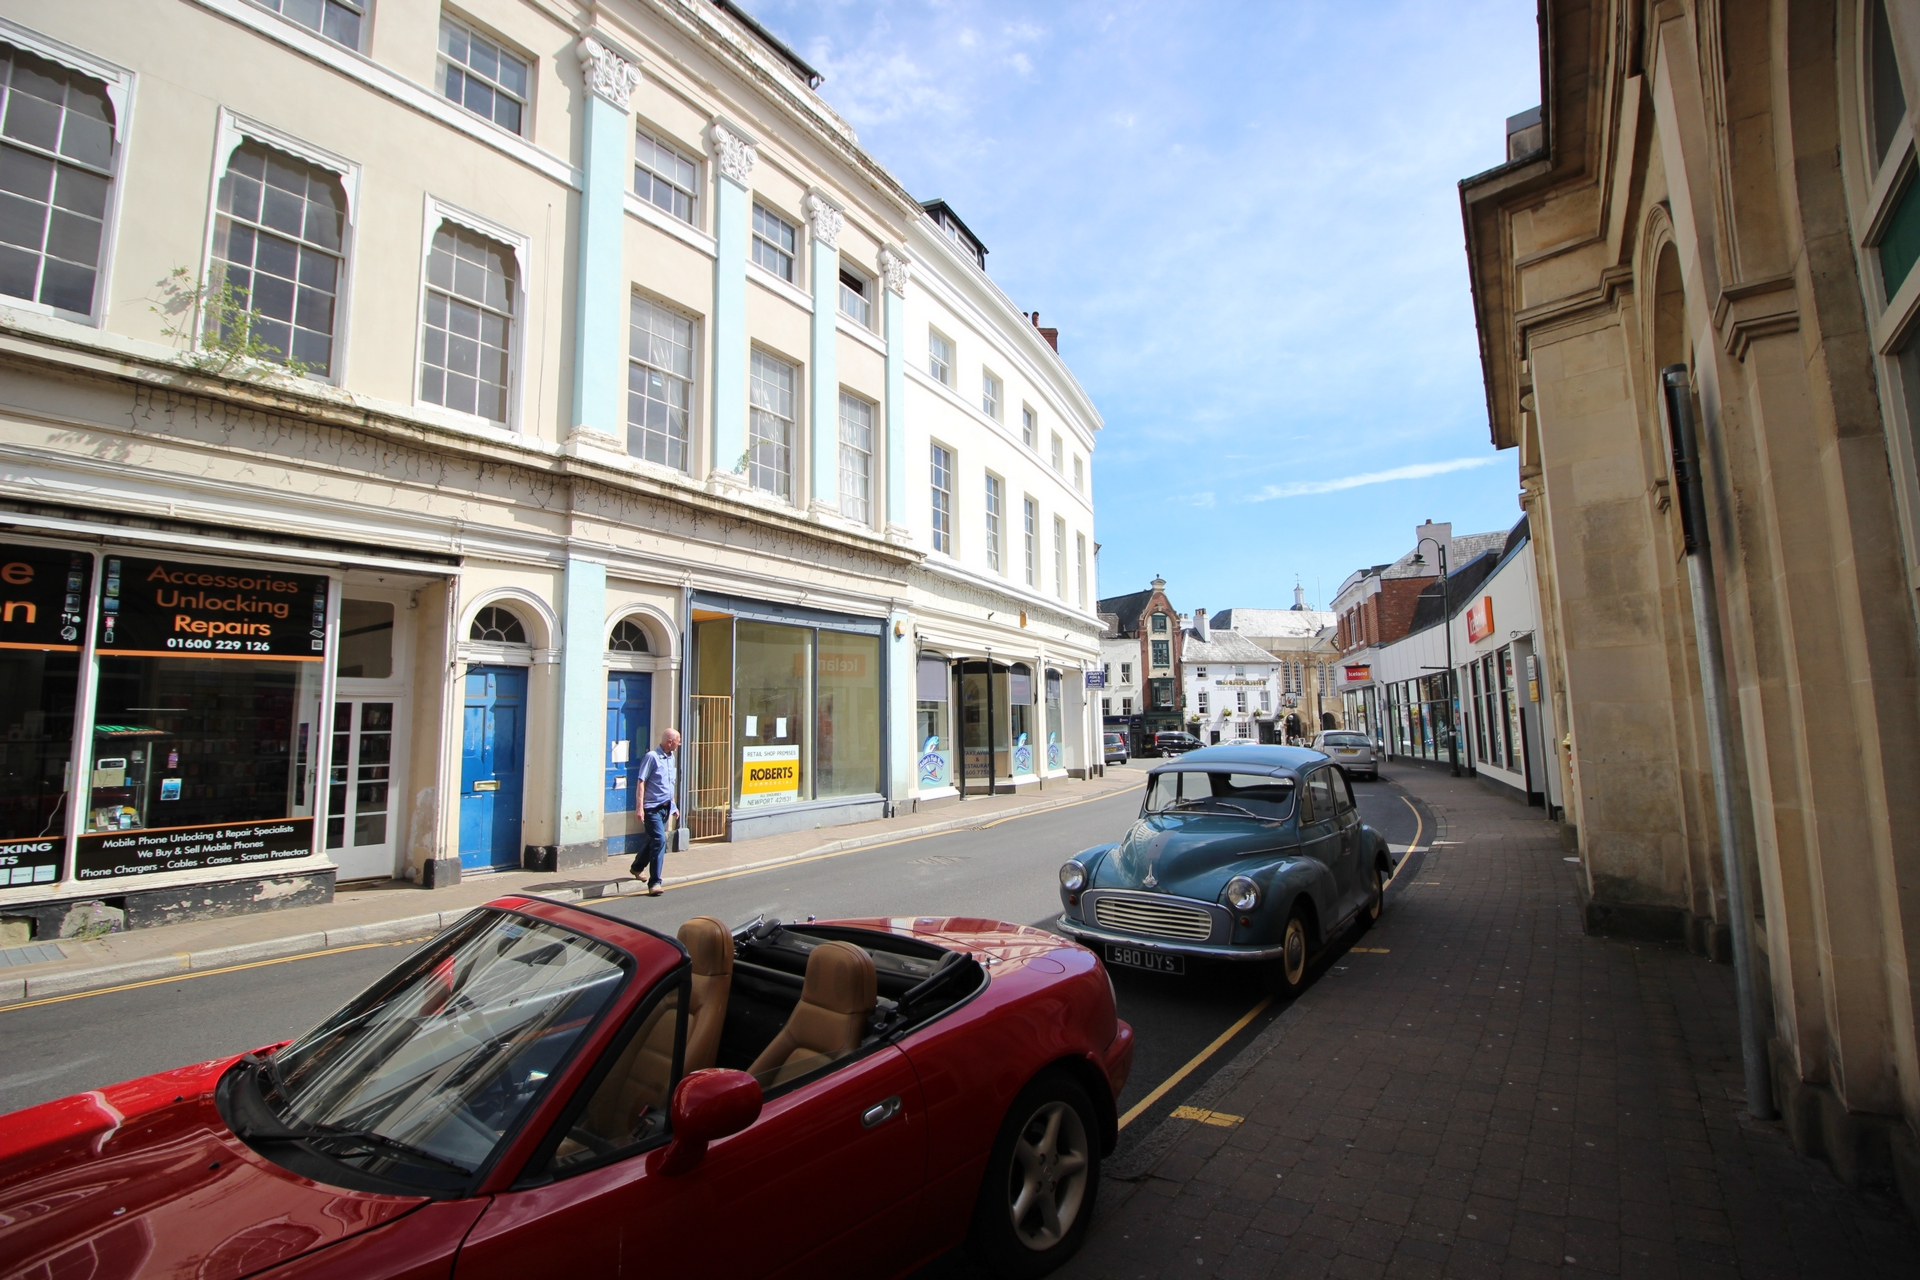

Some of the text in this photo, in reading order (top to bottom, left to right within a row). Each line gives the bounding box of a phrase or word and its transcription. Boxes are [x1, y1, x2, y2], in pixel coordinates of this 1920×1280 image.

[147, 565, 298, 593] Accessories
[156, 588, 289, 619] Unlocking
[174, 614, 271, 638] Repairs
[167, 638, 270, 651] 01600 229 126
[1348, 670, 1368, 678] Iceland
[750, 766, 793, 781] ROBERTS
[747, 797, 774, 806] NEWPORT
[102, 825, 294, 848] Mobile Phone Unlocking & Repair Specialists
[137, 840, 264, 858] We Buy & Sell Mobile Phones
[80, 868, 112, 878] Phone
[114, 863, 158, 874] Chargers
[167, 858, 198, 869] Cables
[207, 856, 233, 865] Cases
[240, 852, 269, 861] Screen
[270, 848, 309, 858] Protectors
[1114, 947, 1175, 971] 580 UYS
